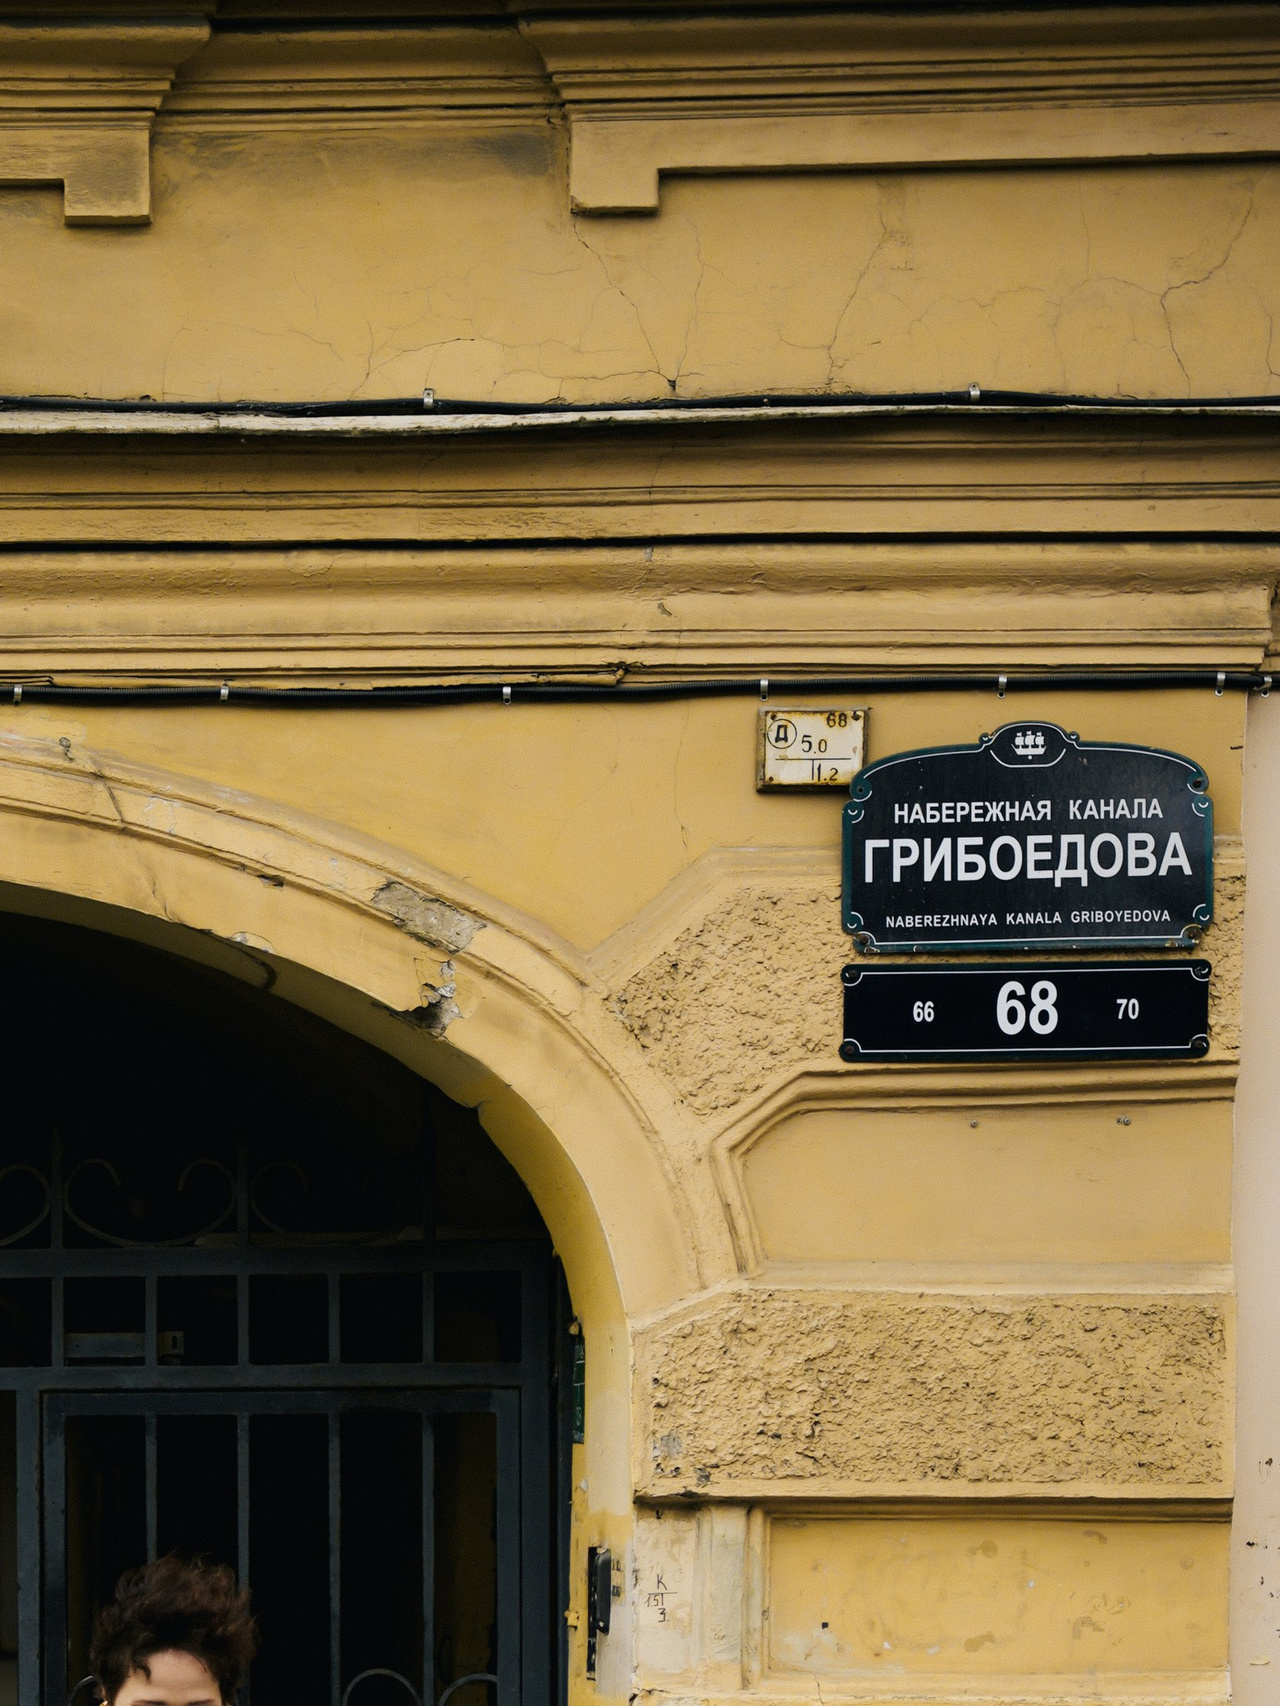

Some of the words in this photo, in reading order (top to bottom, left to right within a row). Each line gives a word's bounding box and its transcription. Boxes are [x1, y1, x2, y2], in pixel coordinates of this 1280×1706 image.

[826, 712, 847, 728] 68
[774, 724, 789, 743] Д
[801, 734, 828, 754] 5.0
[894, 800, 1052, 824] НАБЕРЕЖНАЯ
[1069, 798, 1164, 820] КАНАЛА
[864, 831, 1193, 888] ГРИБОЕДОВА
[885, 913, 998, 928] NABEREZHNAYA
[1006, 911, 1062, 925] KANALA
[1070, 909, 1171, 923] GRIBOYEDOVA
[913, 1001, 935, 1022] 66
[996, 980, 1059, 1035] 68
[1116, 998, 1139, 1020] 70
